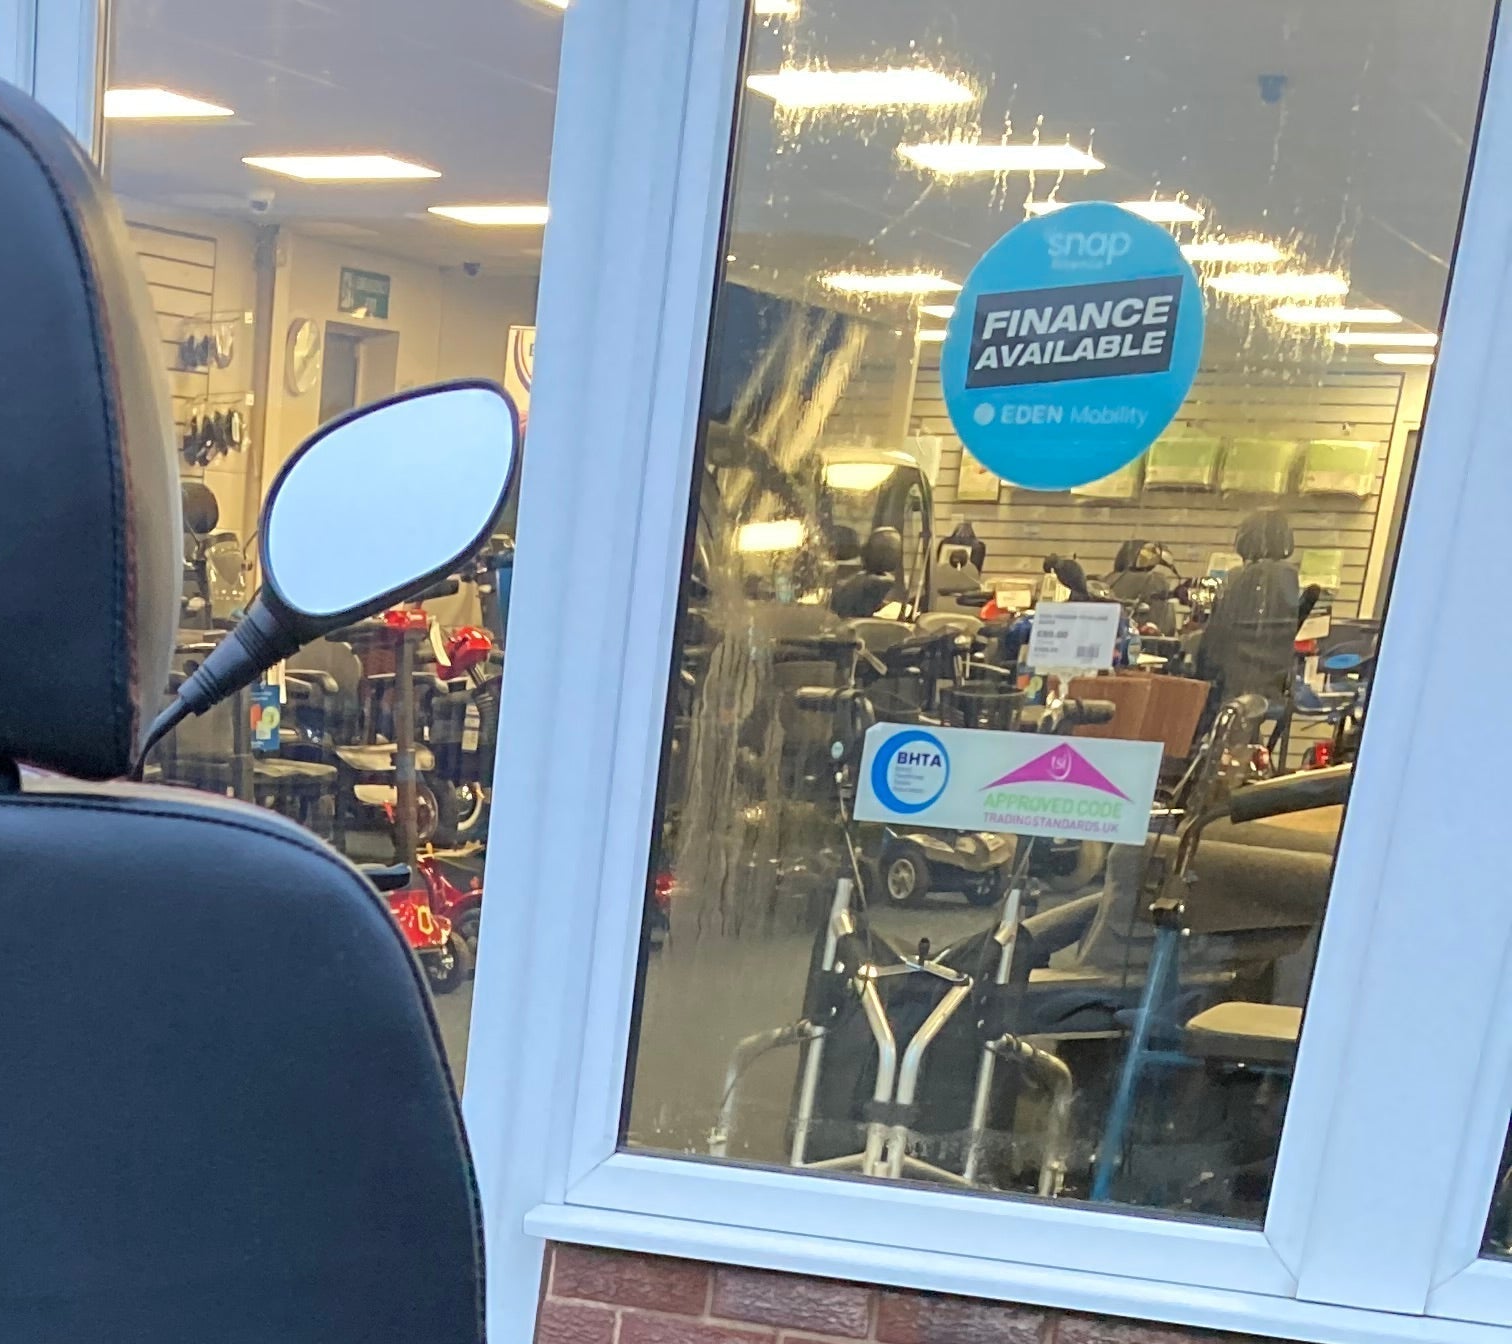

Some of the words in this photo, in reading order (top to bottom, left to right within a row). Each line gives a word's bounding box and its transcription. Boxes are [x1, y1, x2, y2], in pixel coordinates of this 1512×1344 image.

[1047, 231, 1131, 264] snap
[982, 295, 1173, 340] FINANCE
[974, 330, 1166, 370] AVAILABLE
[1000, 404, 1063, 425] EDEN
[1071, 405, 1149, 429] Mobility
[897, 751, 941, 767] BHTA
[984, 792, 1073, 815] APPROVED
[1078, 801, 1121, 818] CODE
